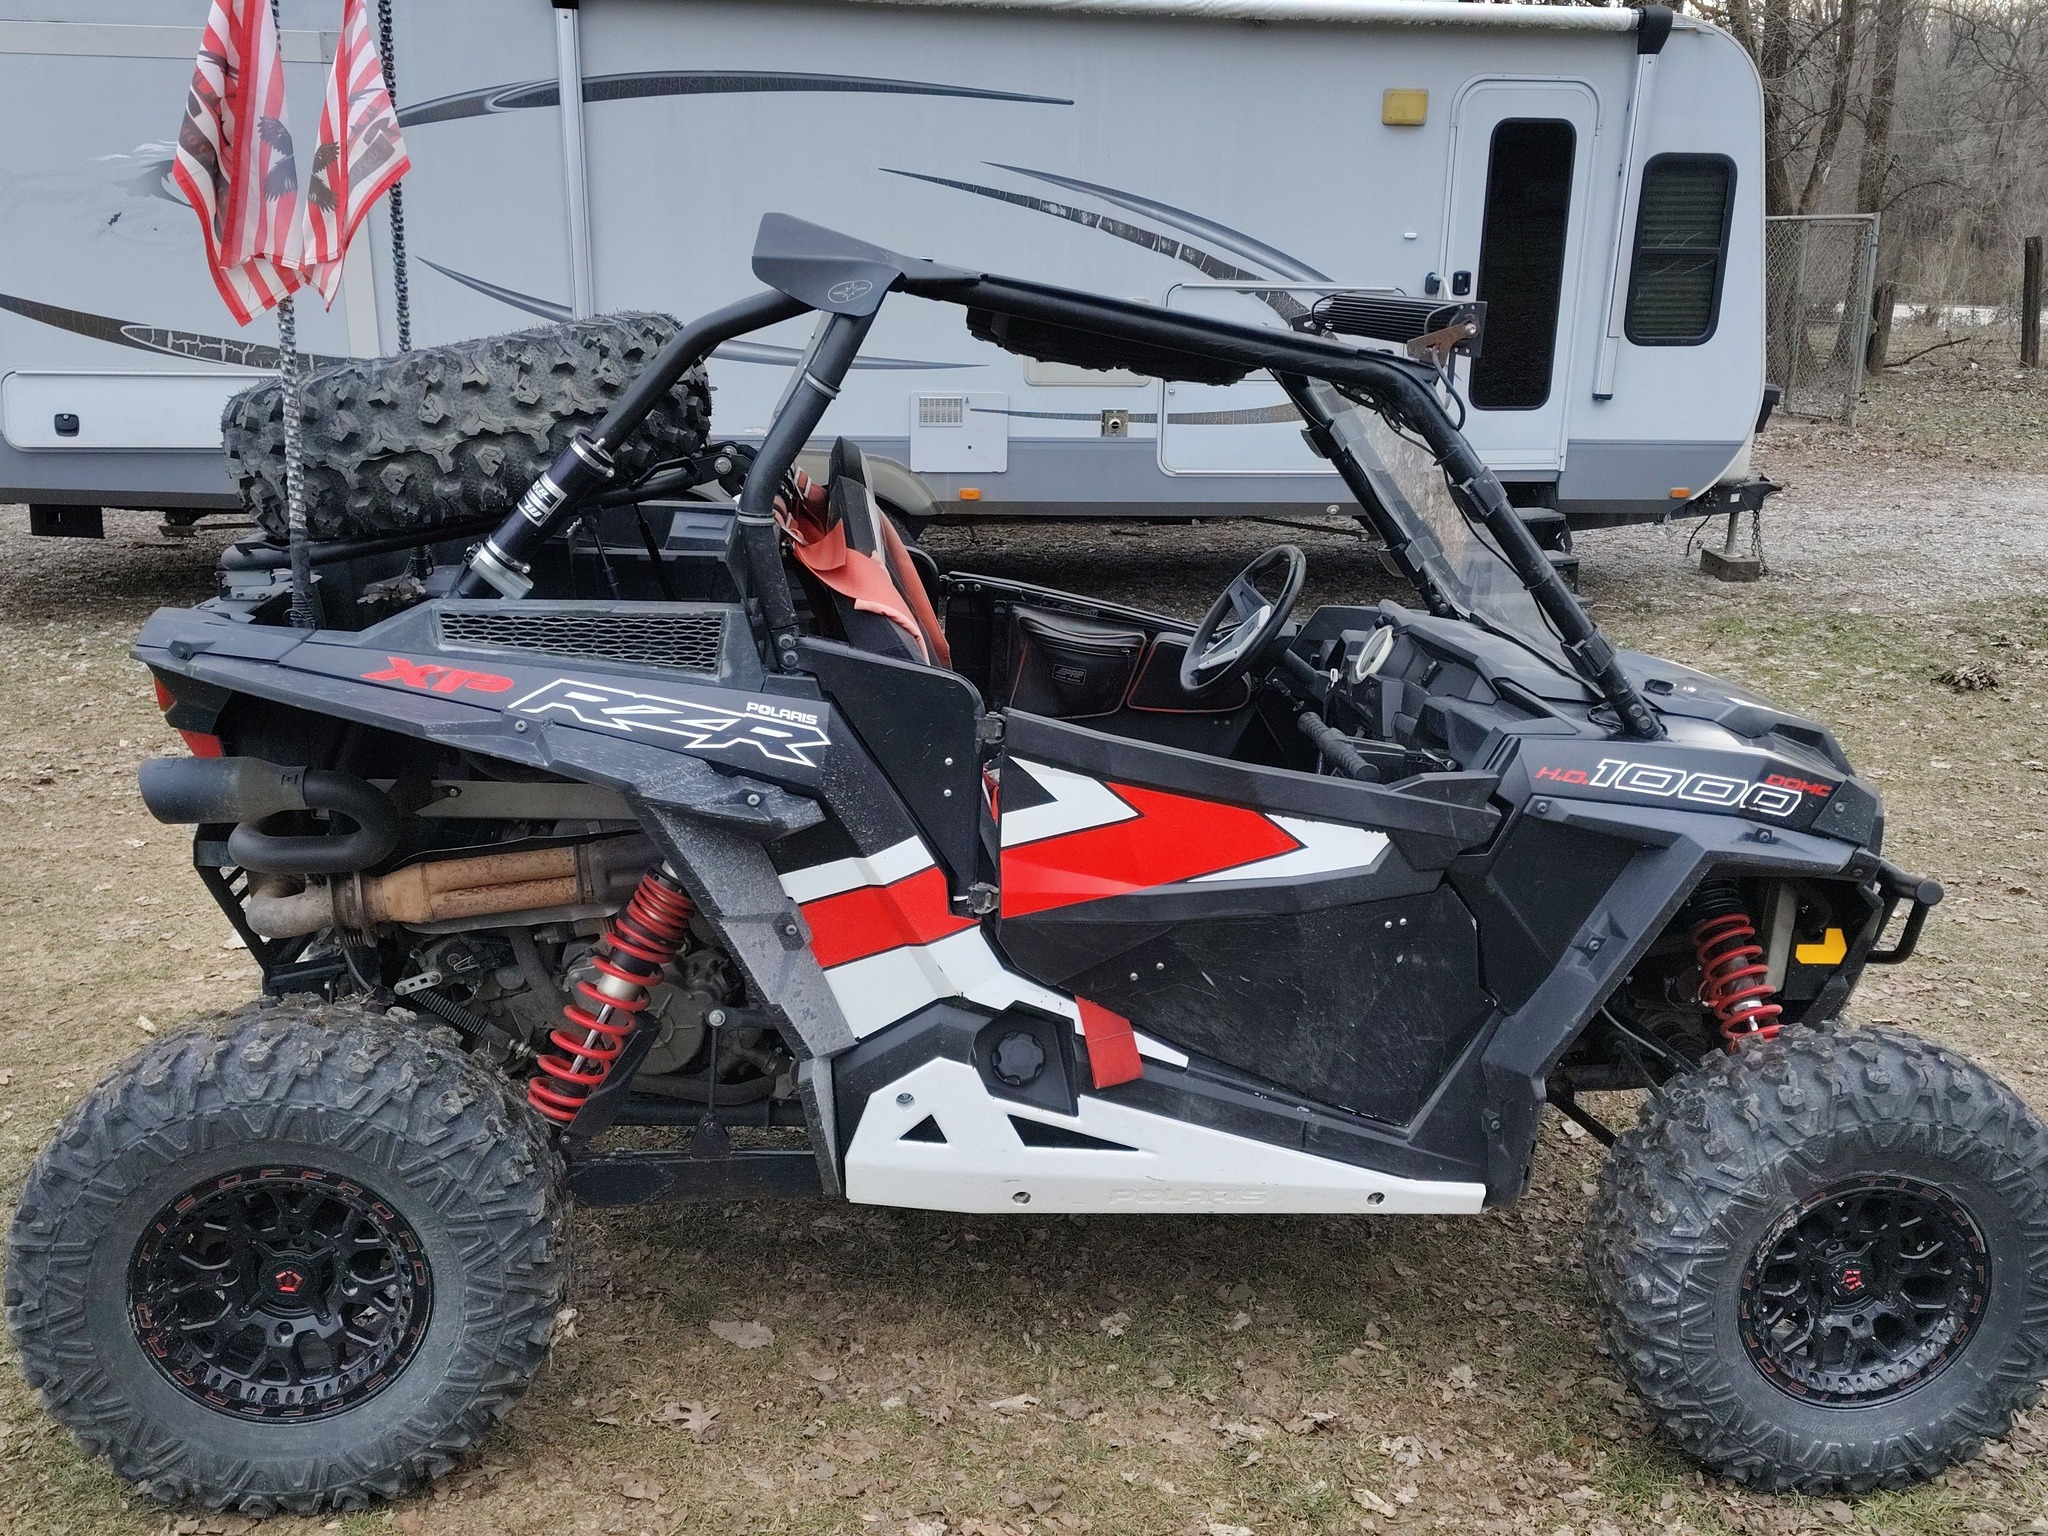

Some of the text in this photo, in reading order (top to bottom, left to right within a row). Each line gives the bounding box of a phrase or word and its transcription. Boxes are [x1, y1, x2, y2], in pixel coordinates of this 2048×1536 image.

[361, 656, 514, 694] XP
[507, 678, 831, 768] RZR
[746, 701, 818, 725] POLARIS
[1589, 758, 1802, 817] 1000
[1765, 774, 1833, 797] DOHC
[1109, 1188, 1269, 1205] POLARIS
